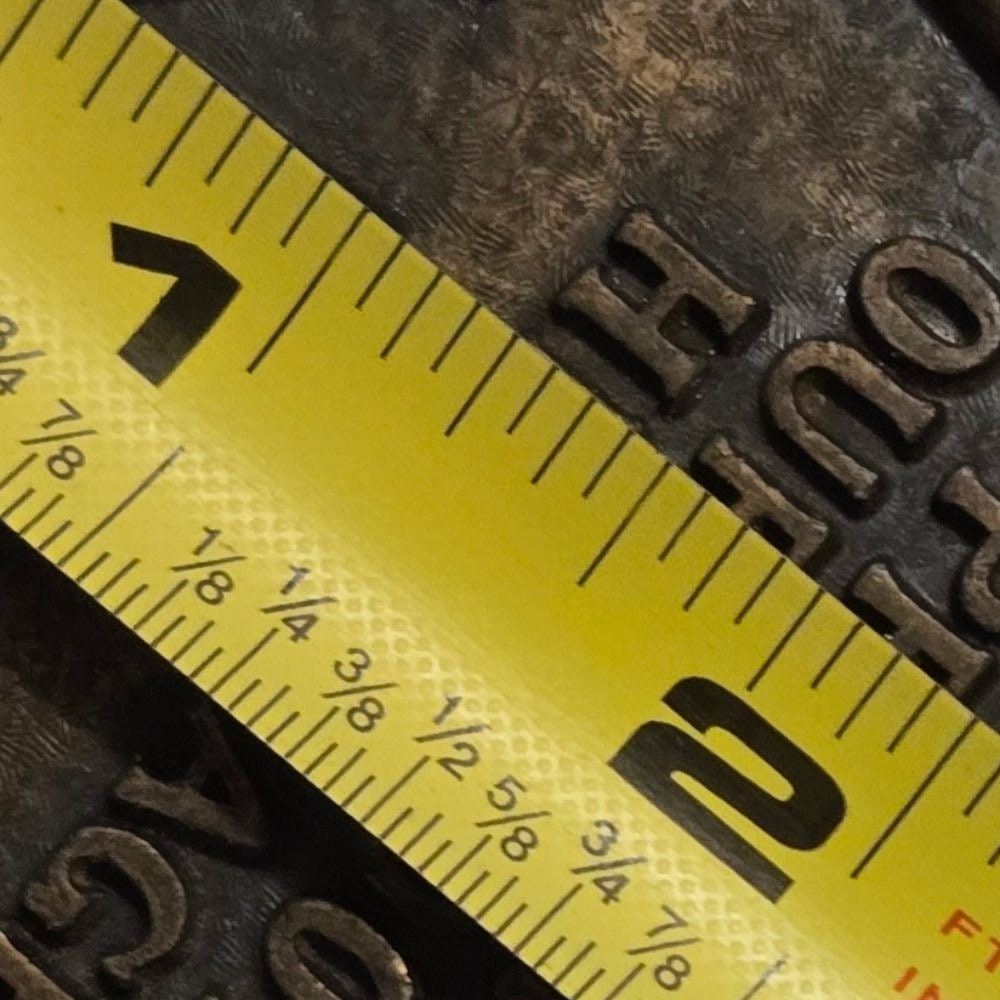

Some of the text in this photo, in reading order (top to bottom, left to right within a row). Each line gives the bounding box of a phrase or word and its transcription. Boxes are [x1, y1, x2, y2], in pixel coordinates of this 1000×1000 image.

[111, 223, 241, 387] 1
[21, 398, 98, 480] 7/8
[172, 527, 245, 604] 1/8
[261, 568, 335, 640] 1/4
[324, 648, 398, 732] 3/8
[416, 697, 490, 778] 1/2
[476, 777, 550, 861] 5/8
[609, 677, 847, 903] 2
[572, 821, 645, 905] 3/4
[629, 907, 700, 990] 7/8
